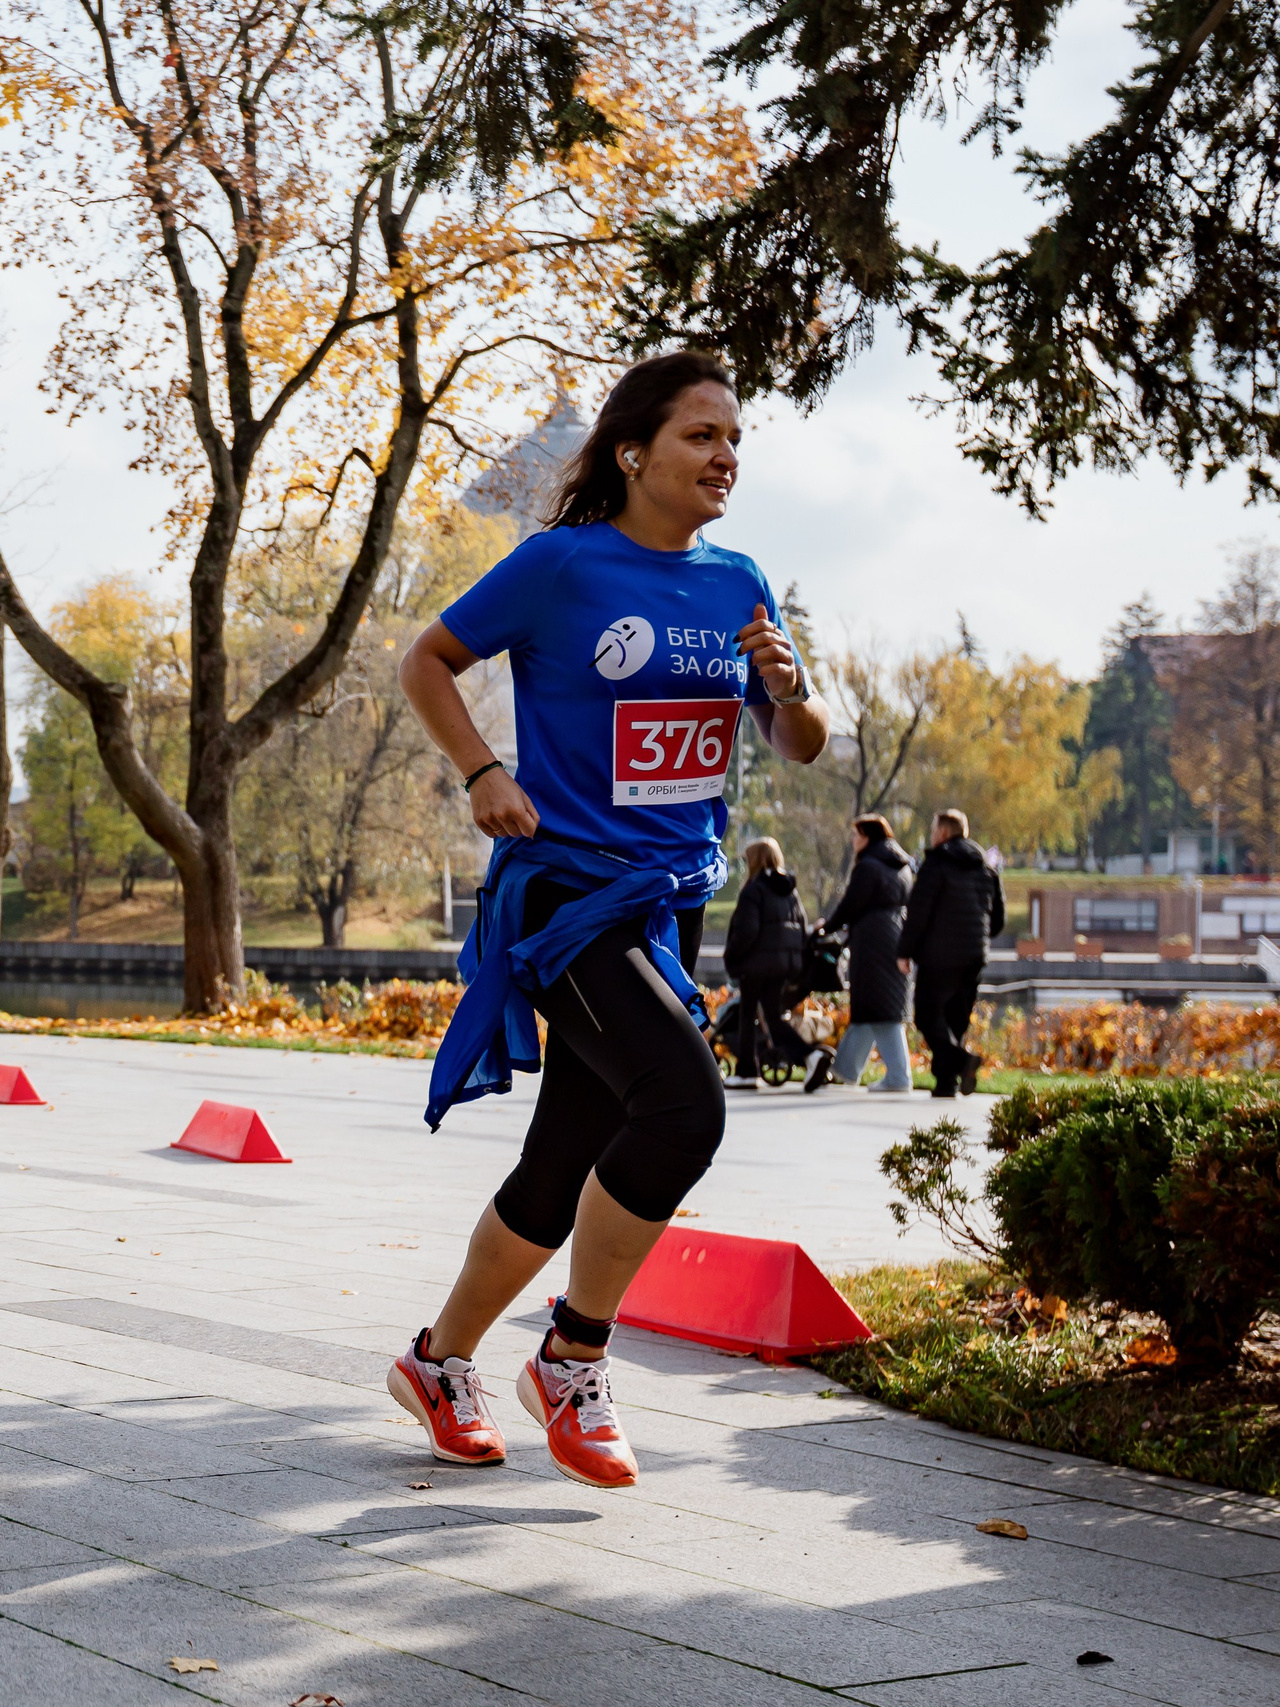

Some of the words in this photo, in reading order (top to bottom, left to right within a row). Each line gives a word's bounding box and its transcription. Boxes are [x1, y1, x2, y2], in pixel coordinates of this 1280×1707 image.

[666, 626, 727, 650] БЕГУ
[670, 653, 702, 676] ЗА
[628, 717, 725, 772] 376
[647, 785, 677, 796] ОРБИ
